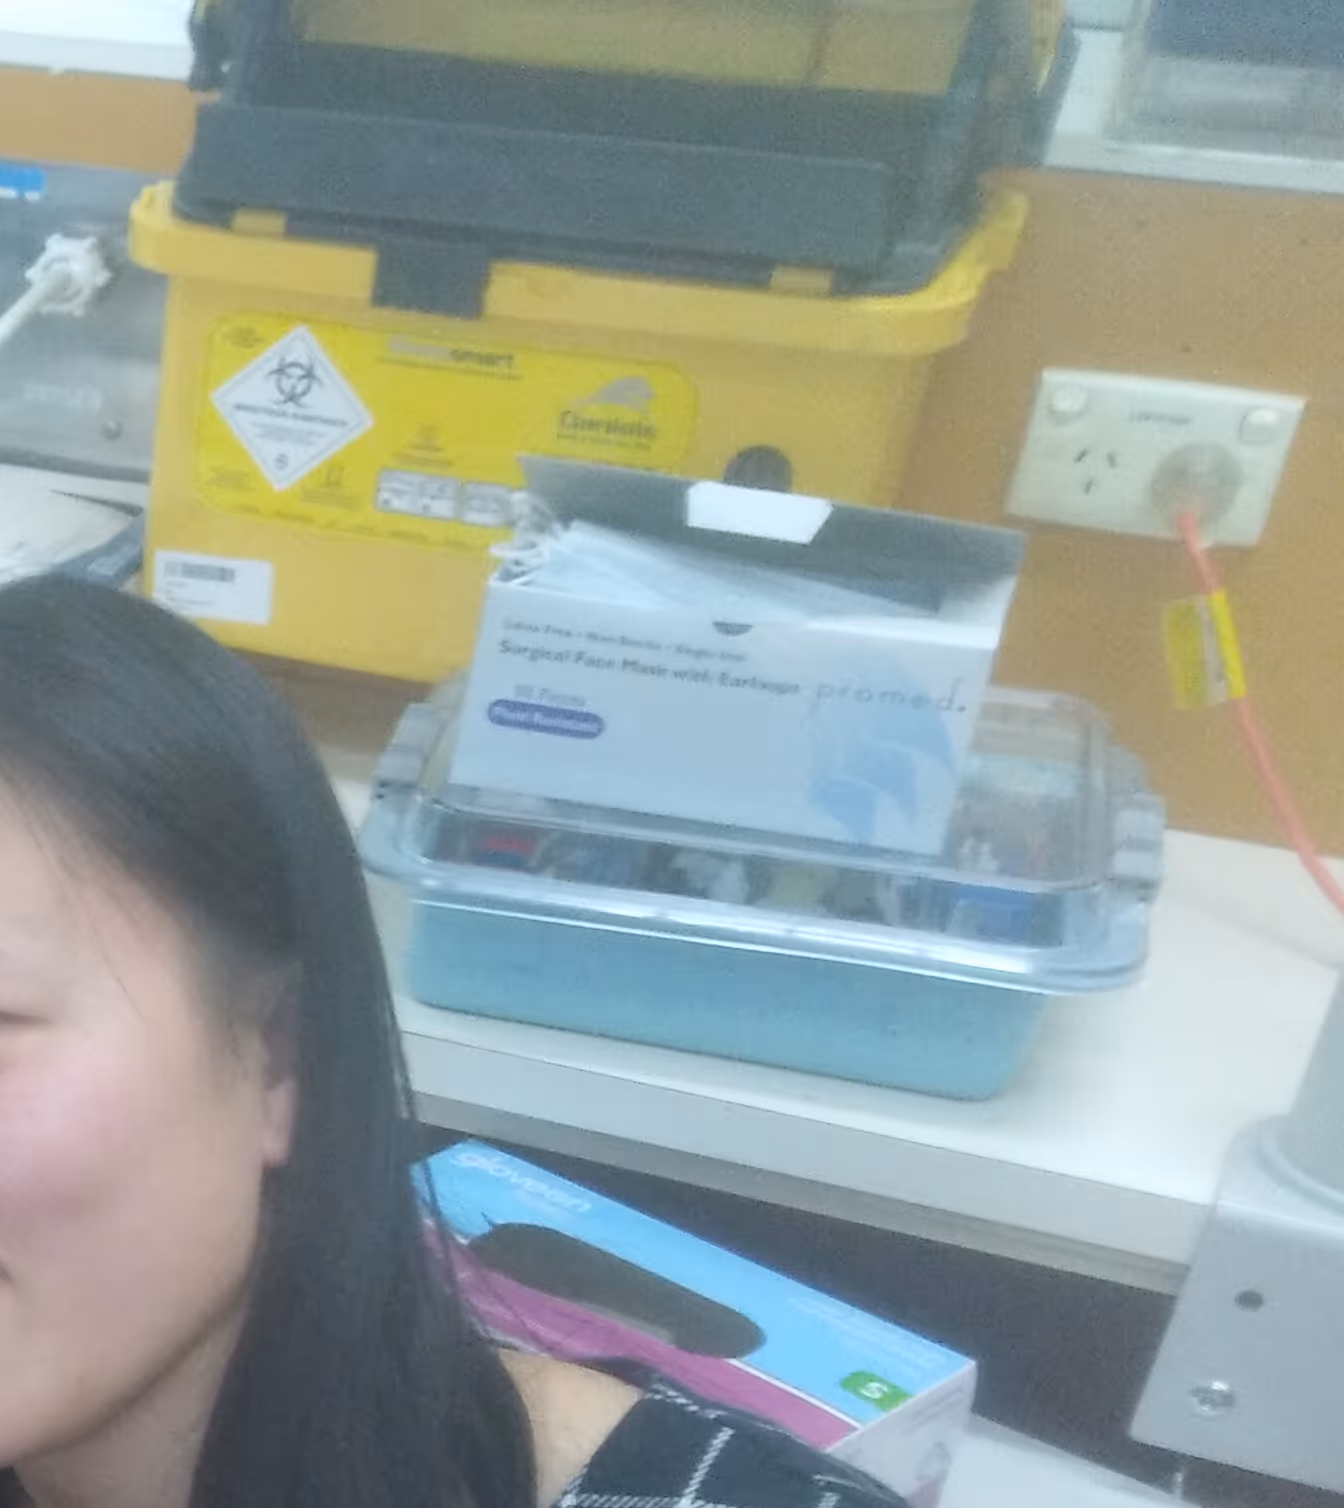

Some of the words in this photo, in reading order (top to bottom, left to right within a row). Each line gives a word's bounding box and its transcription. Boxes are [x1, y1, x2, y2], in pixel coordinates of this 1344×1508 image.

[499, 640, 570, 663] Surgical
[575, 650, 616, 670] Face
[622, 657, 667, 678] Mask
[673, 666, 711, 683] with
[859, 1380, 889, 1400] S
